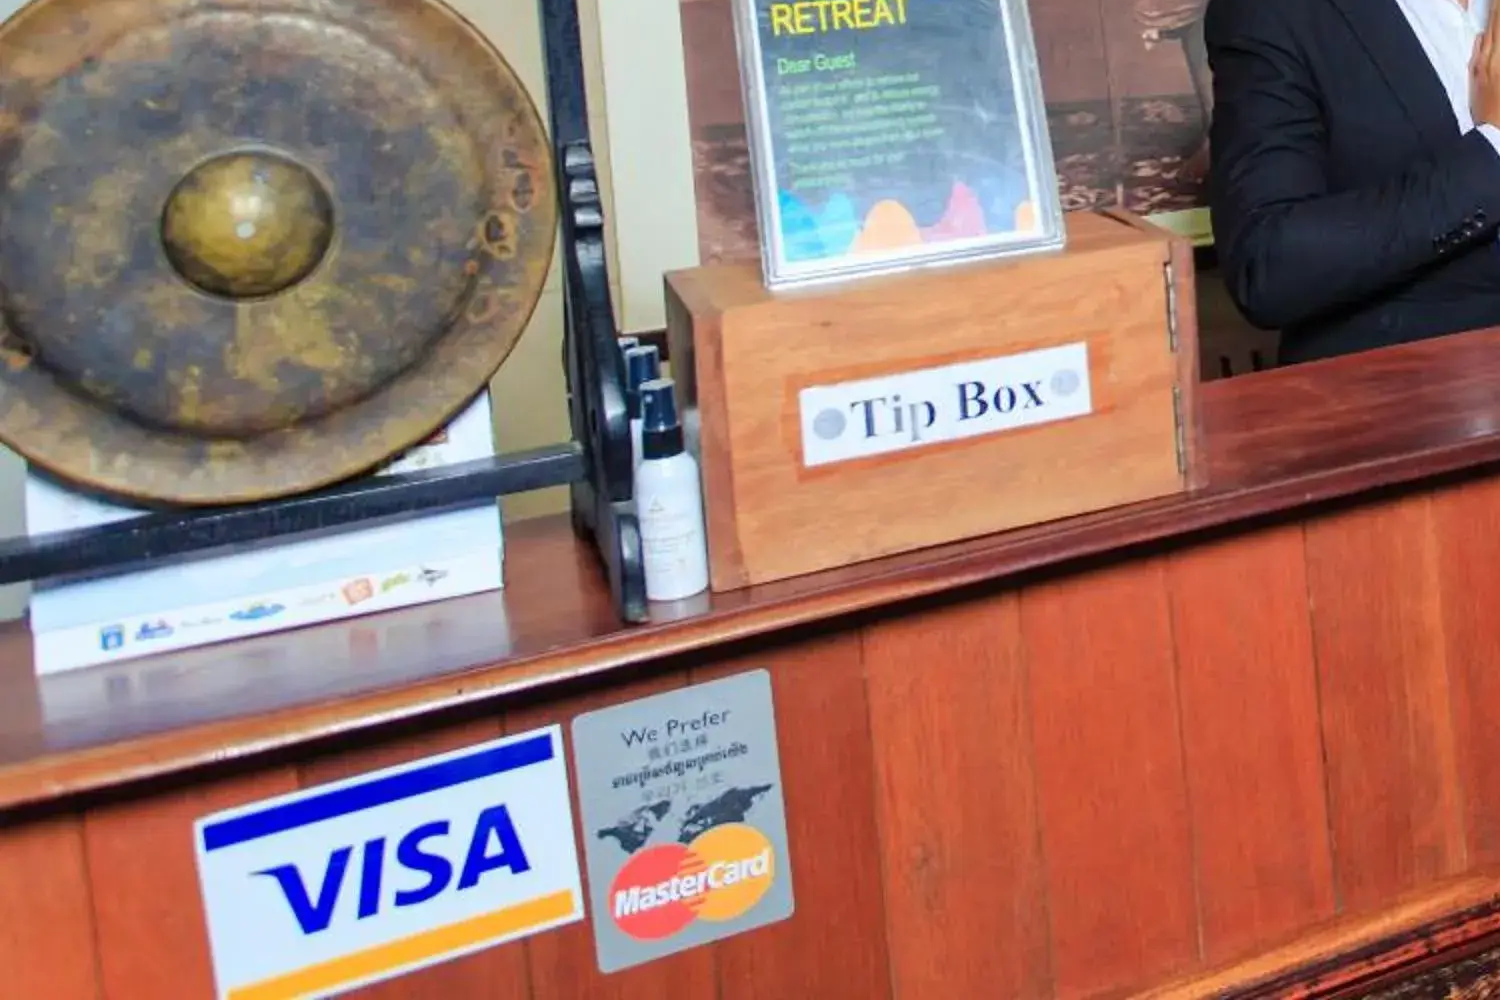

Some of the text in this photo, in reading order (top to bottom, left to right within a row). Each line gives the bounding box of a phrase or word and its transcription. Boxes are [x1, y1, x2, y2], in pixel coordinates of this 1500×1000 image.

[777, 52, 856, 75] Dear Guest
[850, 380, 1044, 442] Tip Box
[621, 709, 731, 749] We Prefer
[249, 803, 531, 934] VISA
[615, 846, 771, 918] MasterCard
